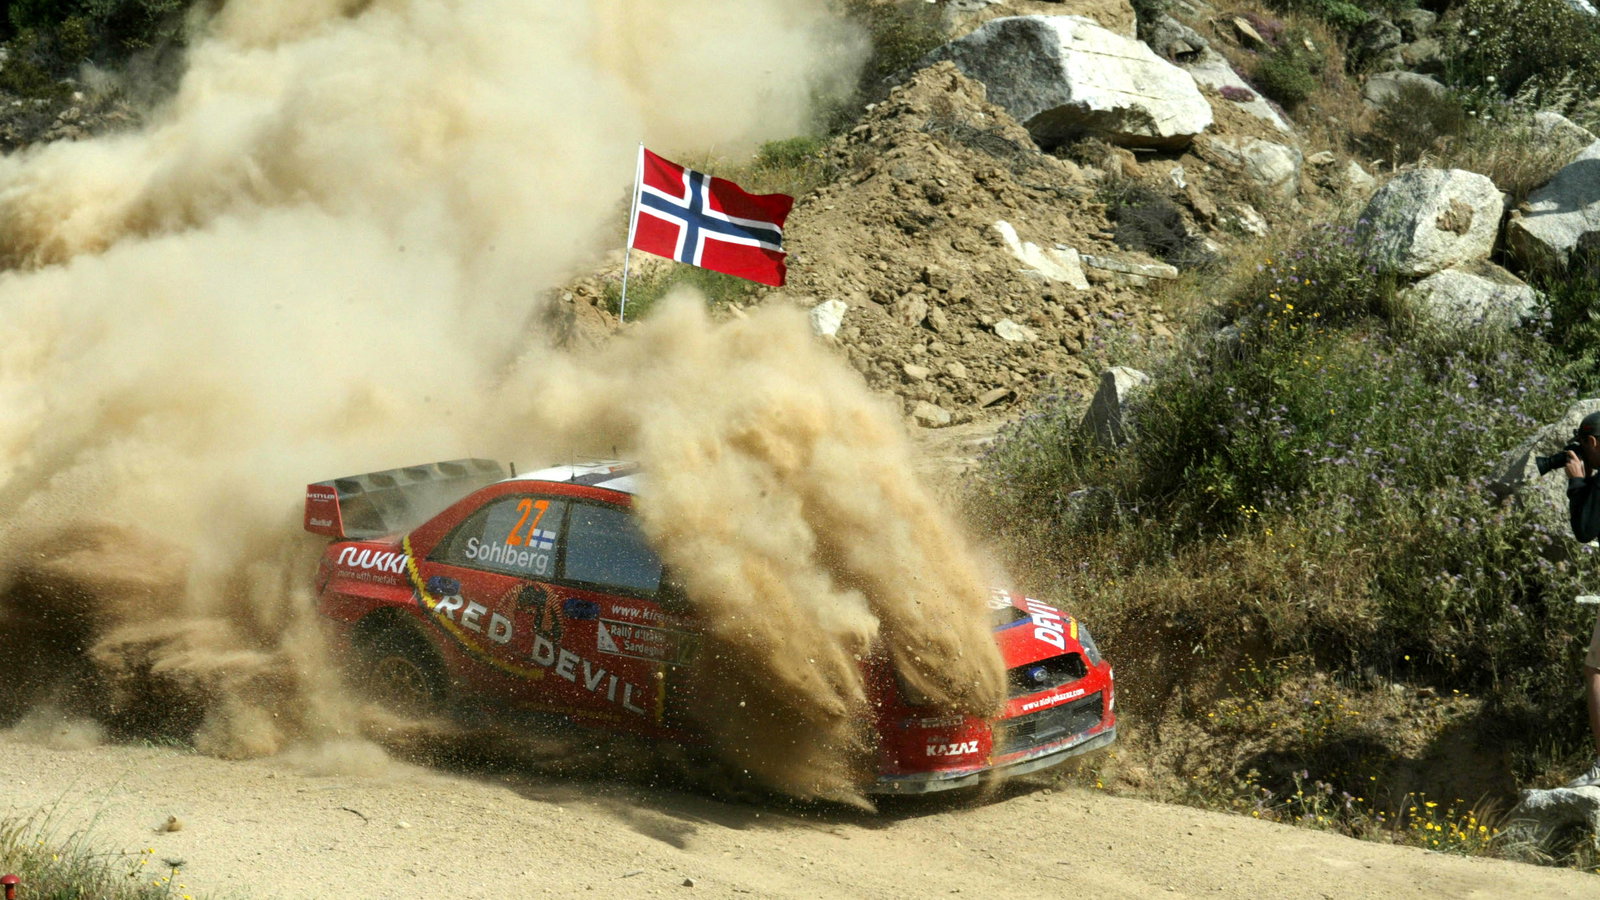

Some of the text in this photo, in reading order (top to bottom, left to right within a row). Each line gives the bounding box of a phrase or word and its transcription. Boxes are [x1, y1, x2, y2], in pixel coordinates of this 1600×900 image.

[506, 498, 550, 547] 27
[465, 537, 549, 575] Sohlberg
[356, 571, 372, 580] with
[610, 625, 632, 639] Rally
[1025, 597, 1065, 650] DEVIL
[433, 595, 513, 644] RED
[531, 634, 645, 715] DEVIL
[926, 740, 979, 756] KAZAZ
